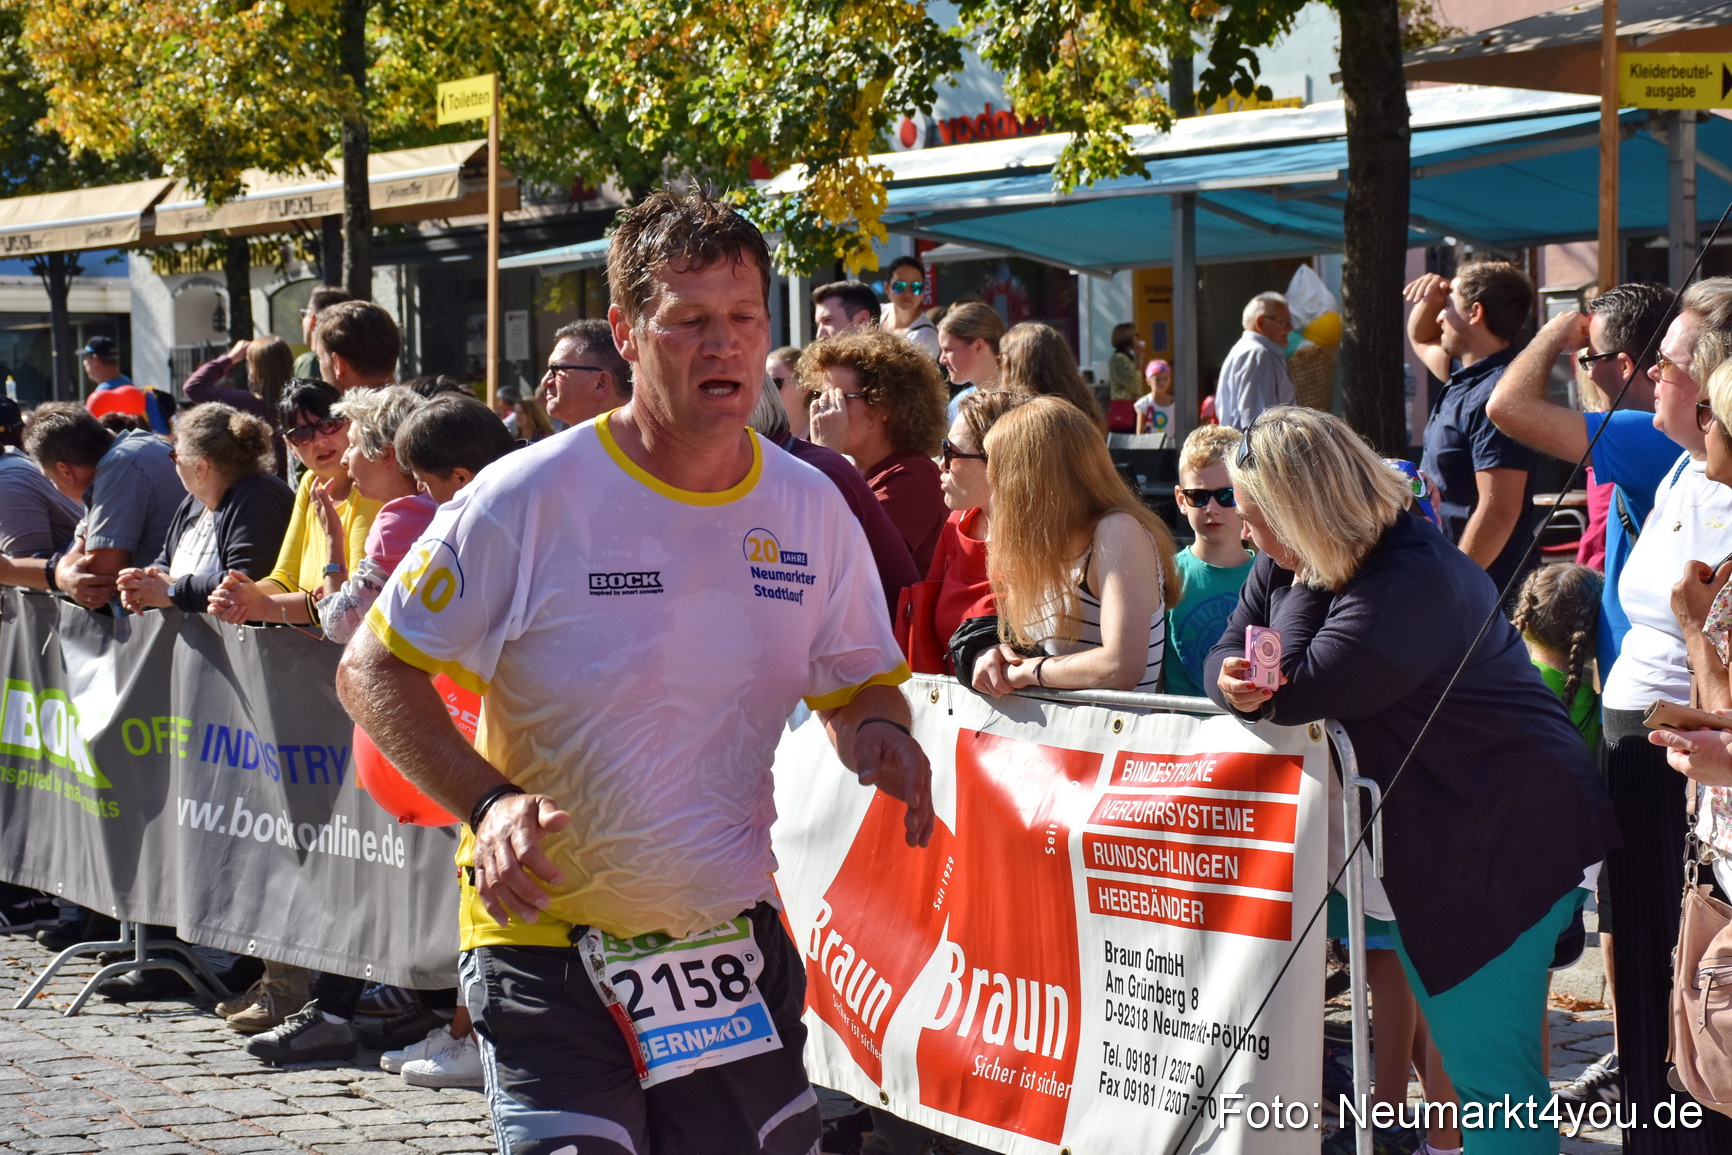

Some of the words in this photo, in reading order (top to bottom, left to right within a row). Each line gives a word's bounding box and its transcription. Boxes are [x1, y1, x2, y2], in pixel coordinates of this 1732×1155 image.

[1630, 63, 1713, 78] Kleiderbeutel-
[448, 91, 489, 110] Toiletten
[1645, 83, 1696, 101] ausgabe
[747, 537, 778, 563] 20
[783, 553, 806, 564] JAHRE
[400, 549, 456, 613] 20
[590, 572, 661, 588] BOCK
[750, 566, 816, 585] Neumarkter
[754, 584, 804, 606] Stadtlauf
[1121, 759, 1216, 782] BINDESTRICKE
[1101, 799, 1255, 832] VERZURRSYSTEME
[1093, 841, 1238, 880] RUNDSCHLINGEN
[933, 888, 946, 911] Seit
[941, 856, 955, 886] 1929
[1098, 887, 1204, 924] HEBEBÄNDER
[806, 897, 893, 1034] Braun
[1104, 940, 1141, 969] Braun
[1145, 948, 1185, 978] GmbH
[611, 954, 750, 1022] 2158
[745, 953, 755, 963] D
[923, 940, 1069, 1061] Braun
[1105, 970, 1124, 996] Am
[1128, 974, 1185, 1014] Grünberg
[1191, 987, 1199, 1010] 8
[832, 994, 850, 1027] Sicher
[851, 1019, 860, 1038] ist
[1105, 999, 1148, 1031] D-92318
[1153, 1010, 1270, 1061] Neumarkt-Pölling
[972, 1054, 1016, 1085] Sicher
[1020, 1066, 1036, 1090] ist
[1037, 1070, 1073, 1100] sicher
[1102, 1041, 1122, 1068] Tel.
[1125, 1047, 1157, 1077] 09181
[1169, 1058, 1204, 1089] 2307-0
[1099, 1071, 1120, 1098] Fax
[1123, 1077, 1156, 1108] 09181
